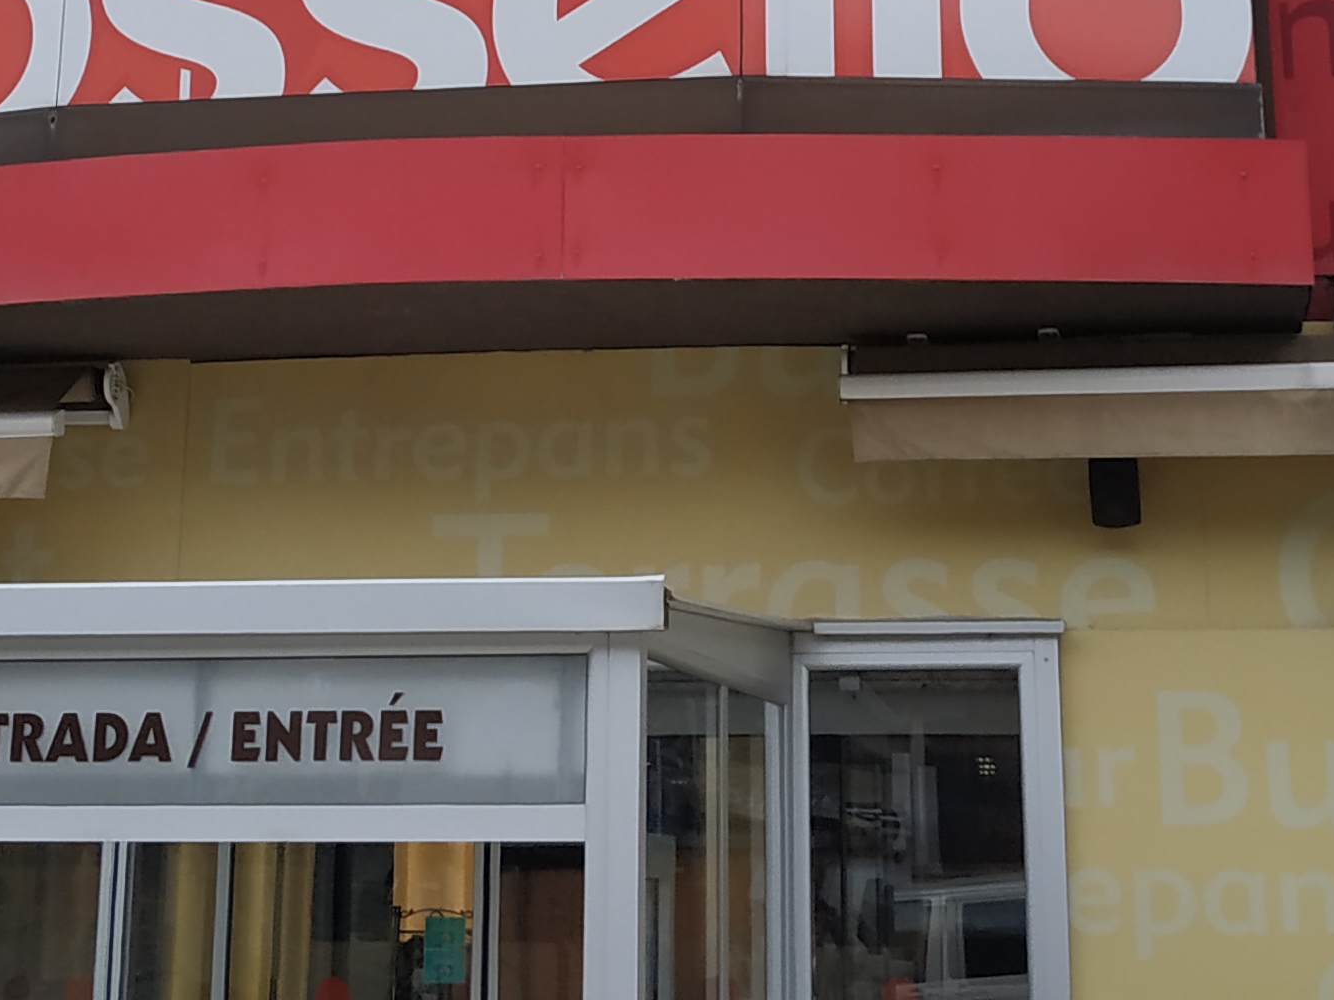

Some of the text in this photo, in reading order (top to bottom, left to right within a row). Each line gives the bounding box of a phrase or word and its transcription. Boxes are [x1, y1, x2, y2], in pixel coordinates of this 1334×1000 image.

[207, 390, 715, 503] Entrepans
[187, 711, 214, 768] /
[229, 692, 444, 763] ENTRÉE
